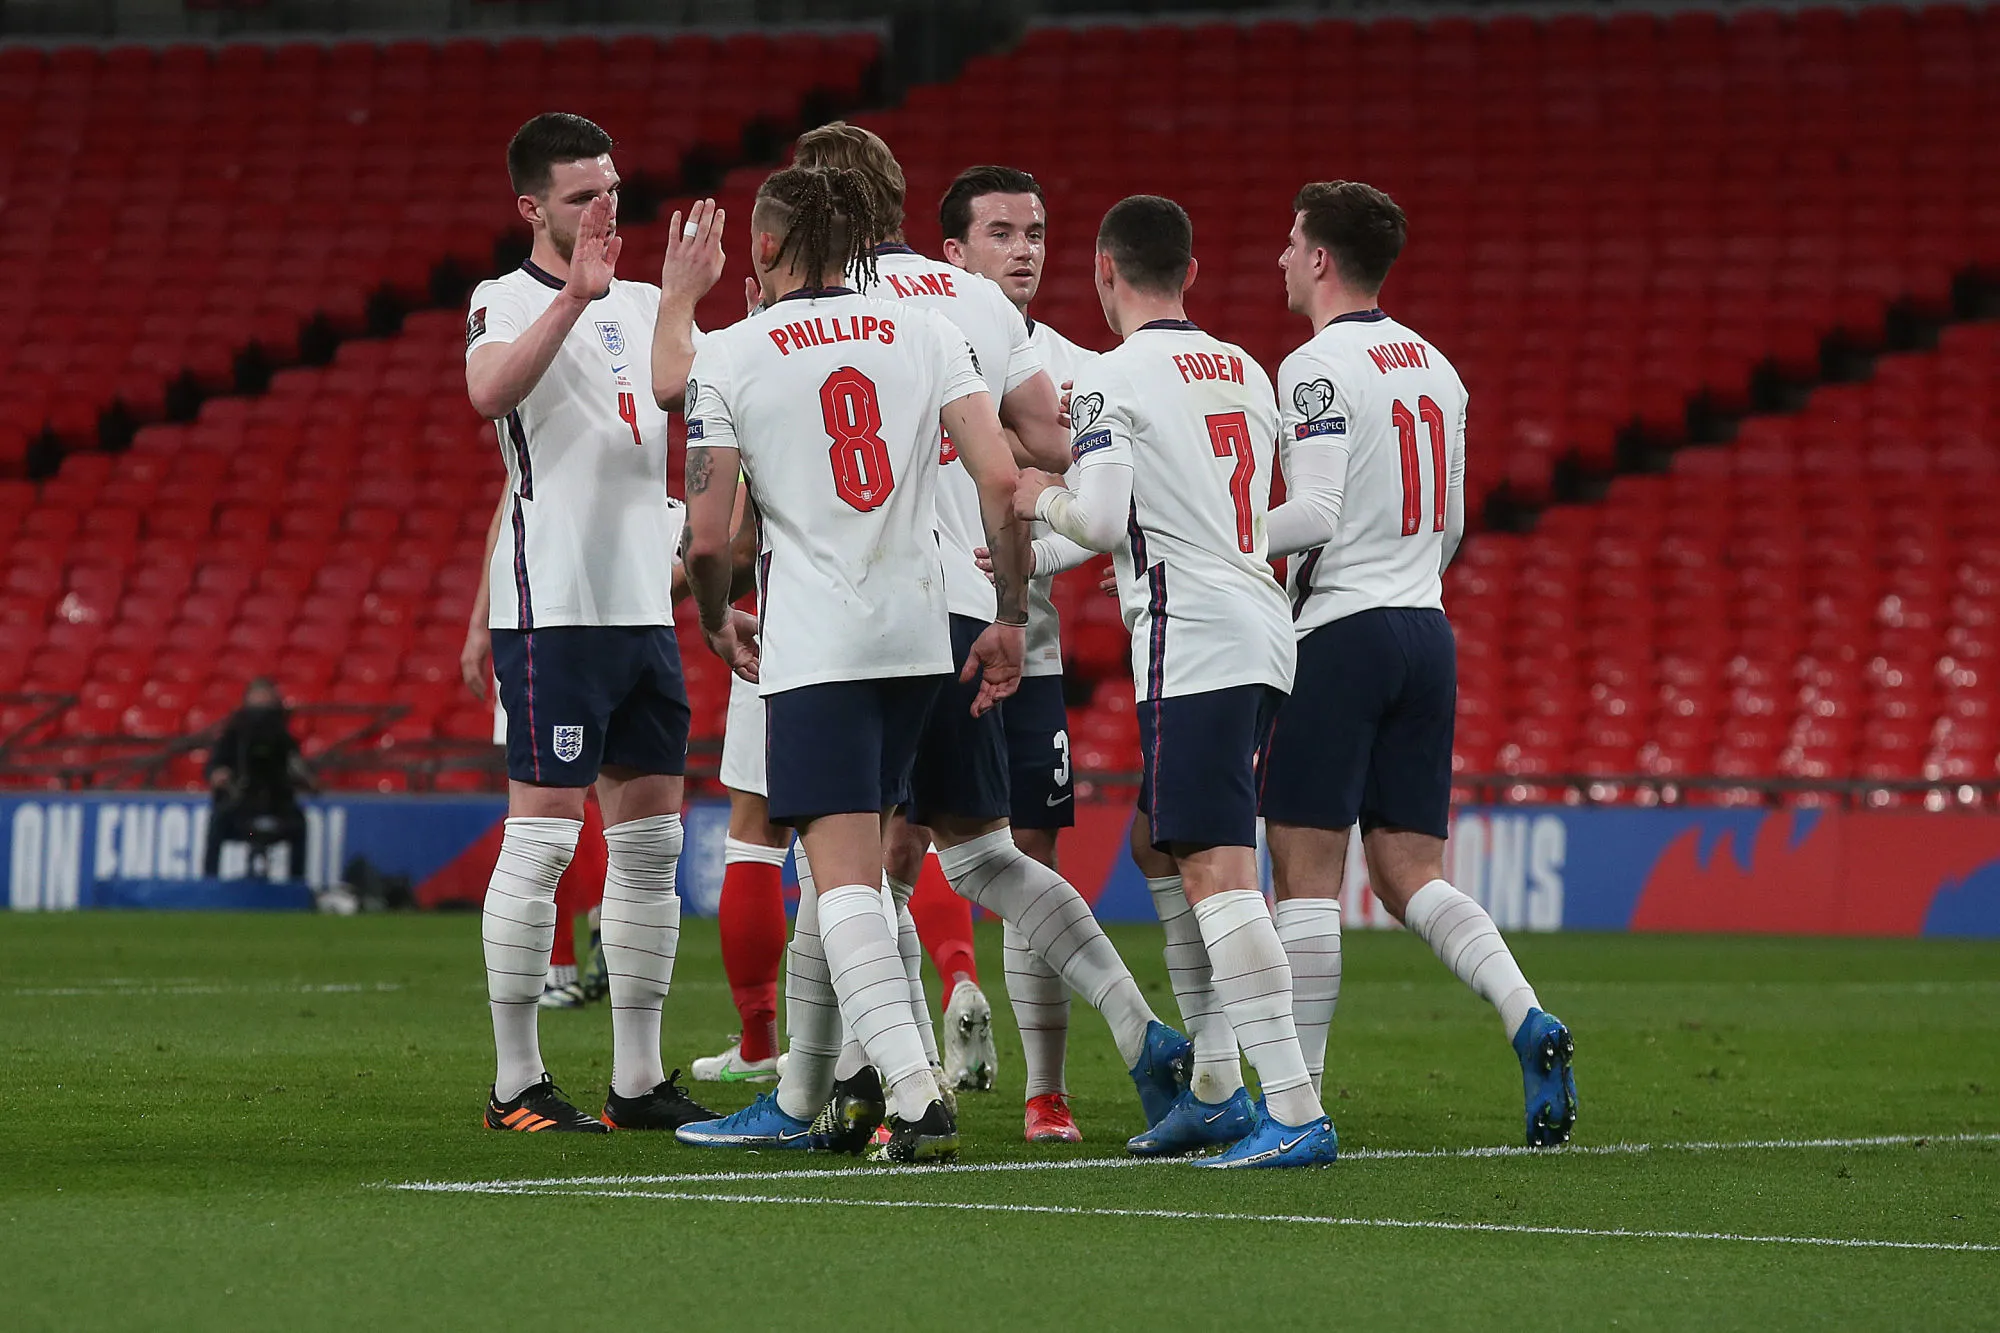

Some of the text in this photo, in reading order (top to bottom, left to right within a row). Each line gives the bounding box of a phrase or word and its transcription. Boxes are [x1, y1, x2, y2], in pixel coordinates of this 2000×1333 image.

[887, 272, 958, 299] KANE
[769, 315, 896, 356] PHILLIPS
[1366, 341, 1432, 375] MOUNT
[1172, 351, 1246, 386] FODEN
[618, 392, 642, 445] 4
[819, 366, 896, 513] 8
[1309, 421, 1345, 433] RESPECT
[1077, 433, 1111, 452] RESPECT
[1392, 394, 1446, 537] 11
[1205, 411, 1256, 554] 7
[1053, 729, 1070, 787] 3
[9, 804, 83, 911] ON
